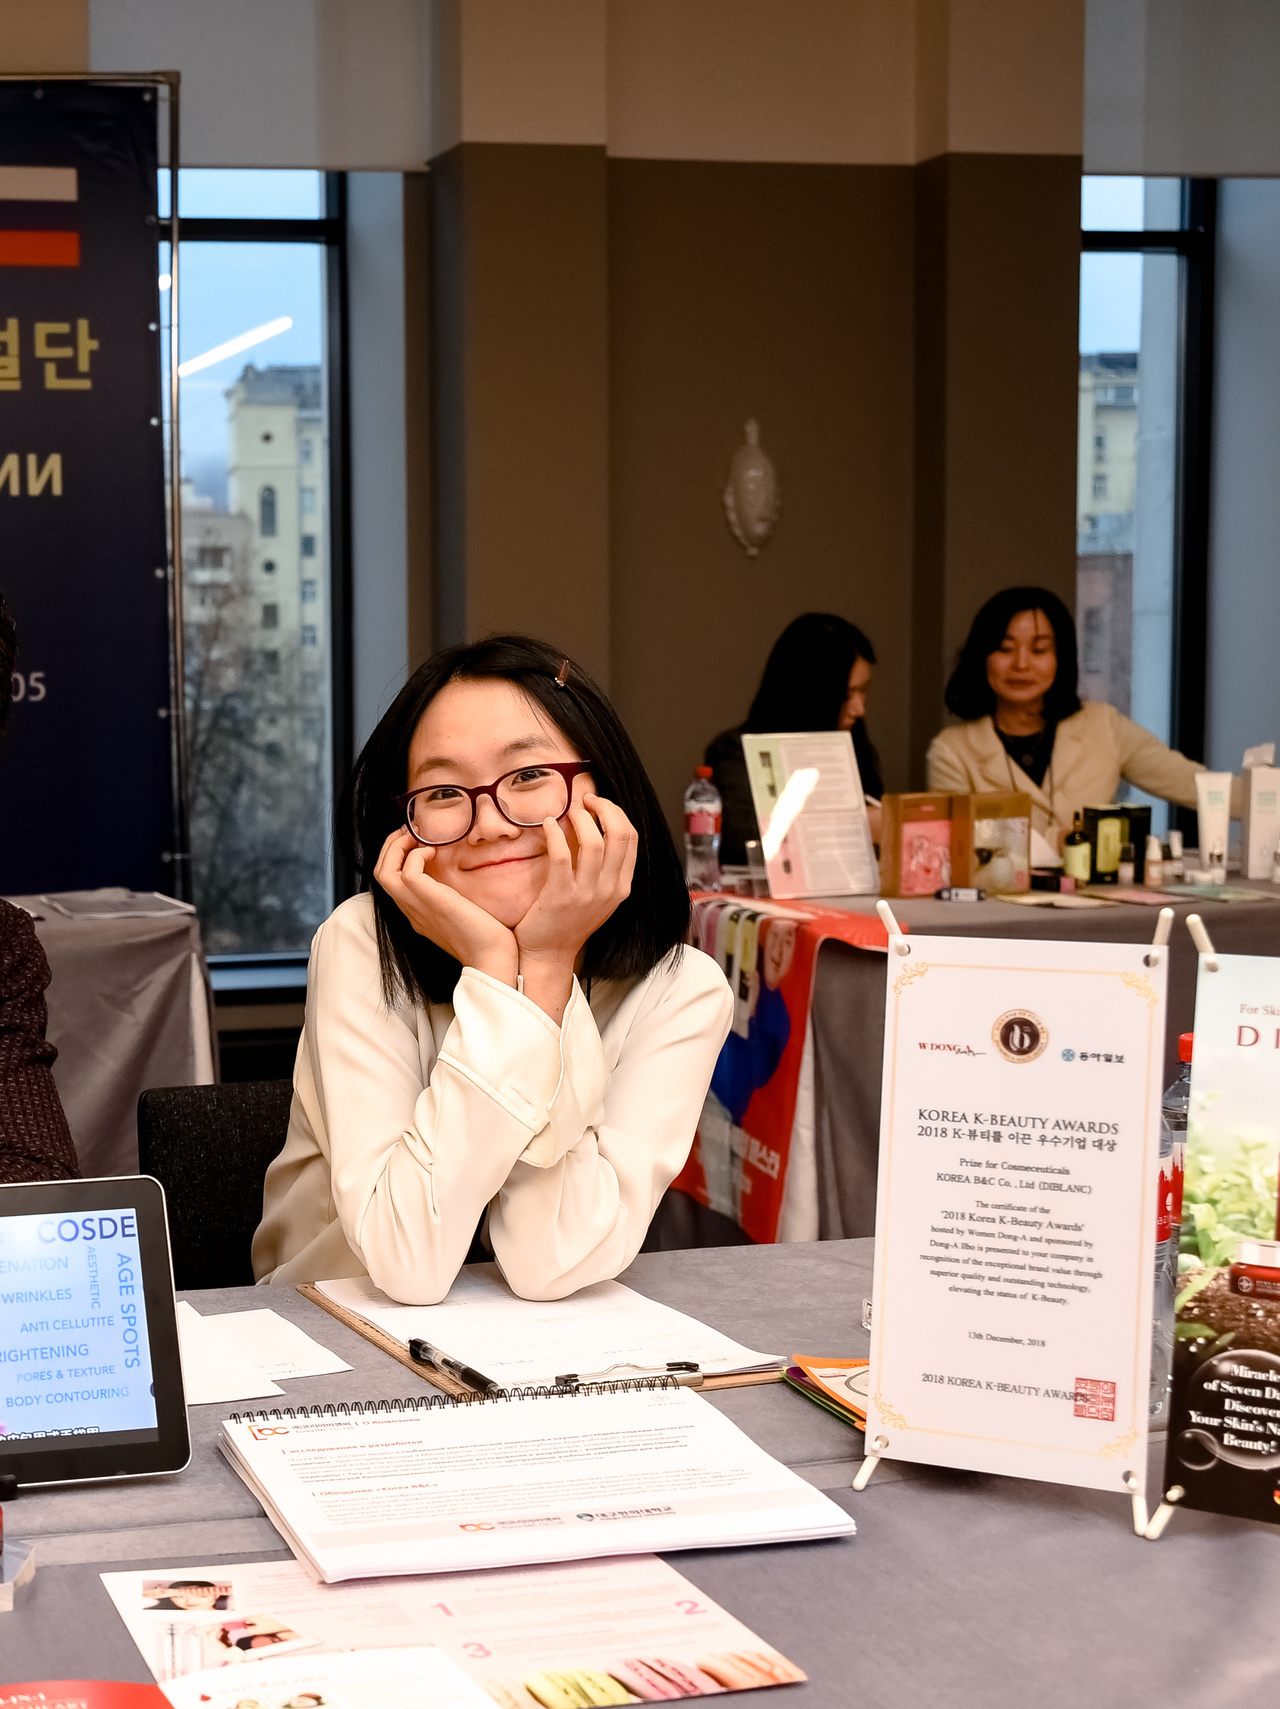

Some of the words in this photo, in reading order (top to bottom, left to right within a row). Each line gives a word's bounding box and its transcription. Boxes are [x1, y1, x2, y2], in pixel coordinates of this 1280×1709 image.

[1239, 1003, 1260, 1015] For
[1078, 1051, 1125, 1064] 동아일보
[918, 1108, 969, 1124] KOREA
[973, 1112, 1050, 1130] K-BEAUTY
[1051, 1118, 1119, 1136] AWARDS
[917, 1125, 948, 1138] 2018
[1036, 1134, 1087, 1151] 우수기업
[1091, 1138, 1117, 1153] 대상
[959, 1158, 982, 1169] Prize
[985, 1160, 998, 1170] for
[1000, 1161, 1071, 1176] Cosmeceuticals
[936, 1172, 971, 1184] KOREA
[973, 1175, 995, 1187] B&C
[1038, 1181, 1093, 1195] (DIBLANC)
[975, 1200, 989, 1209] The
[990, 1201, 1027, 1212] certificate
[1028, 1205, 1038, 1213] of
[1039, 1206, 1051, 1215] the
[37, 1215, 137, 1244] COSDE
[968, 1213, 996, 1224] Korea
[998, 1216, 1043, 1230] K-Beauty
[931, 1225, 955, 1235] hosted
[956, 1227, 965, 1237] by
[967, 1228, 996, 1239] Women
[997, 1231, 1028, 1242] Dong-A
[1029, 1234, 1043, 1243] and
[1044, 1235, 1083, 1247] sponsored
[1084, 1240, 1094, 1249] by
[929, 1239, 959, 1251] Dong-A
[977, 1244, 984, 1252] is
[985, 1244, 1020, 1256] presented
[1021, 1248, 1029, 1256] to
[1031, 1250, 1049, 1260] your
[1050, 1251, 1084, 1263] company
[1086, 1255, 1094, 1263] in
[116, 1252, 135, 1297] AGE
[919, 1254, 961, 1265] recognition
[962, 1256, 971, 1265] of
[972, 1257, 983, 1266] the
[984, 1259, 1027, 1271] exceptional
[1028, 1264, 1050, 1274] brand
[1051, 1267, 1072, 1276] value
[1073, 1269, 1103, 1280] through
[87, 1246, 101, 1309] AESTHETIC
[929, 1269, 959, 1279] superior
[960, 1271, 986, 1283] quality
[987, 1274, 1002, 1283] and
[1002, 1275, 1046, 1288] outstanding
[0, 1288, 72, 1305] WRINKLES
[948, 1285, 982, 1297] elevating
[983, 1288, 995, 1297] the
[996, 1290, 1018, 1299] status
[1019, 1292, 1028, 1300] of
[19, 1320, 50, 1334] ANTI
[52, 1315, 115, 1331] CELLUTITE
[120, 1303, 141, 1369] SPOTS
[968, 1331, 984, 1340] 13th
[1027, 1338, 1047, 1348] 2018
[16, 1369, 53, 1383] PORES
[55, 1369, 65, 1380] &
[67, 1365, 116, 1379] TEXTURE
[6, 1395, 42, 1408] BODY
[45, 1386, 130, 1405] CONTOURING
[921, 1372, 945, 1384] 2018
[947, 1376, 983, 1390] KOREA
[985, 1381, 1041, 1398] K-BEAUTY
[1042, 1388, 1090, 1403] AWARDS
[1203, 1380, 1220, 1392] of
[1220, 1381, 1262, 1399] Seven
[371, 1417, 421, 1426] Компании
[1188, 1409, 1222, 1427] Your
[1223, 1415, 1265, 1434] Skin's
[1222, 1432, 1278, 1455] Beauty!
[430, 1602, 454, 1617] 1
[674, 1599, 708, 1616] 2
[461, 1641, 493, 1660] 3
